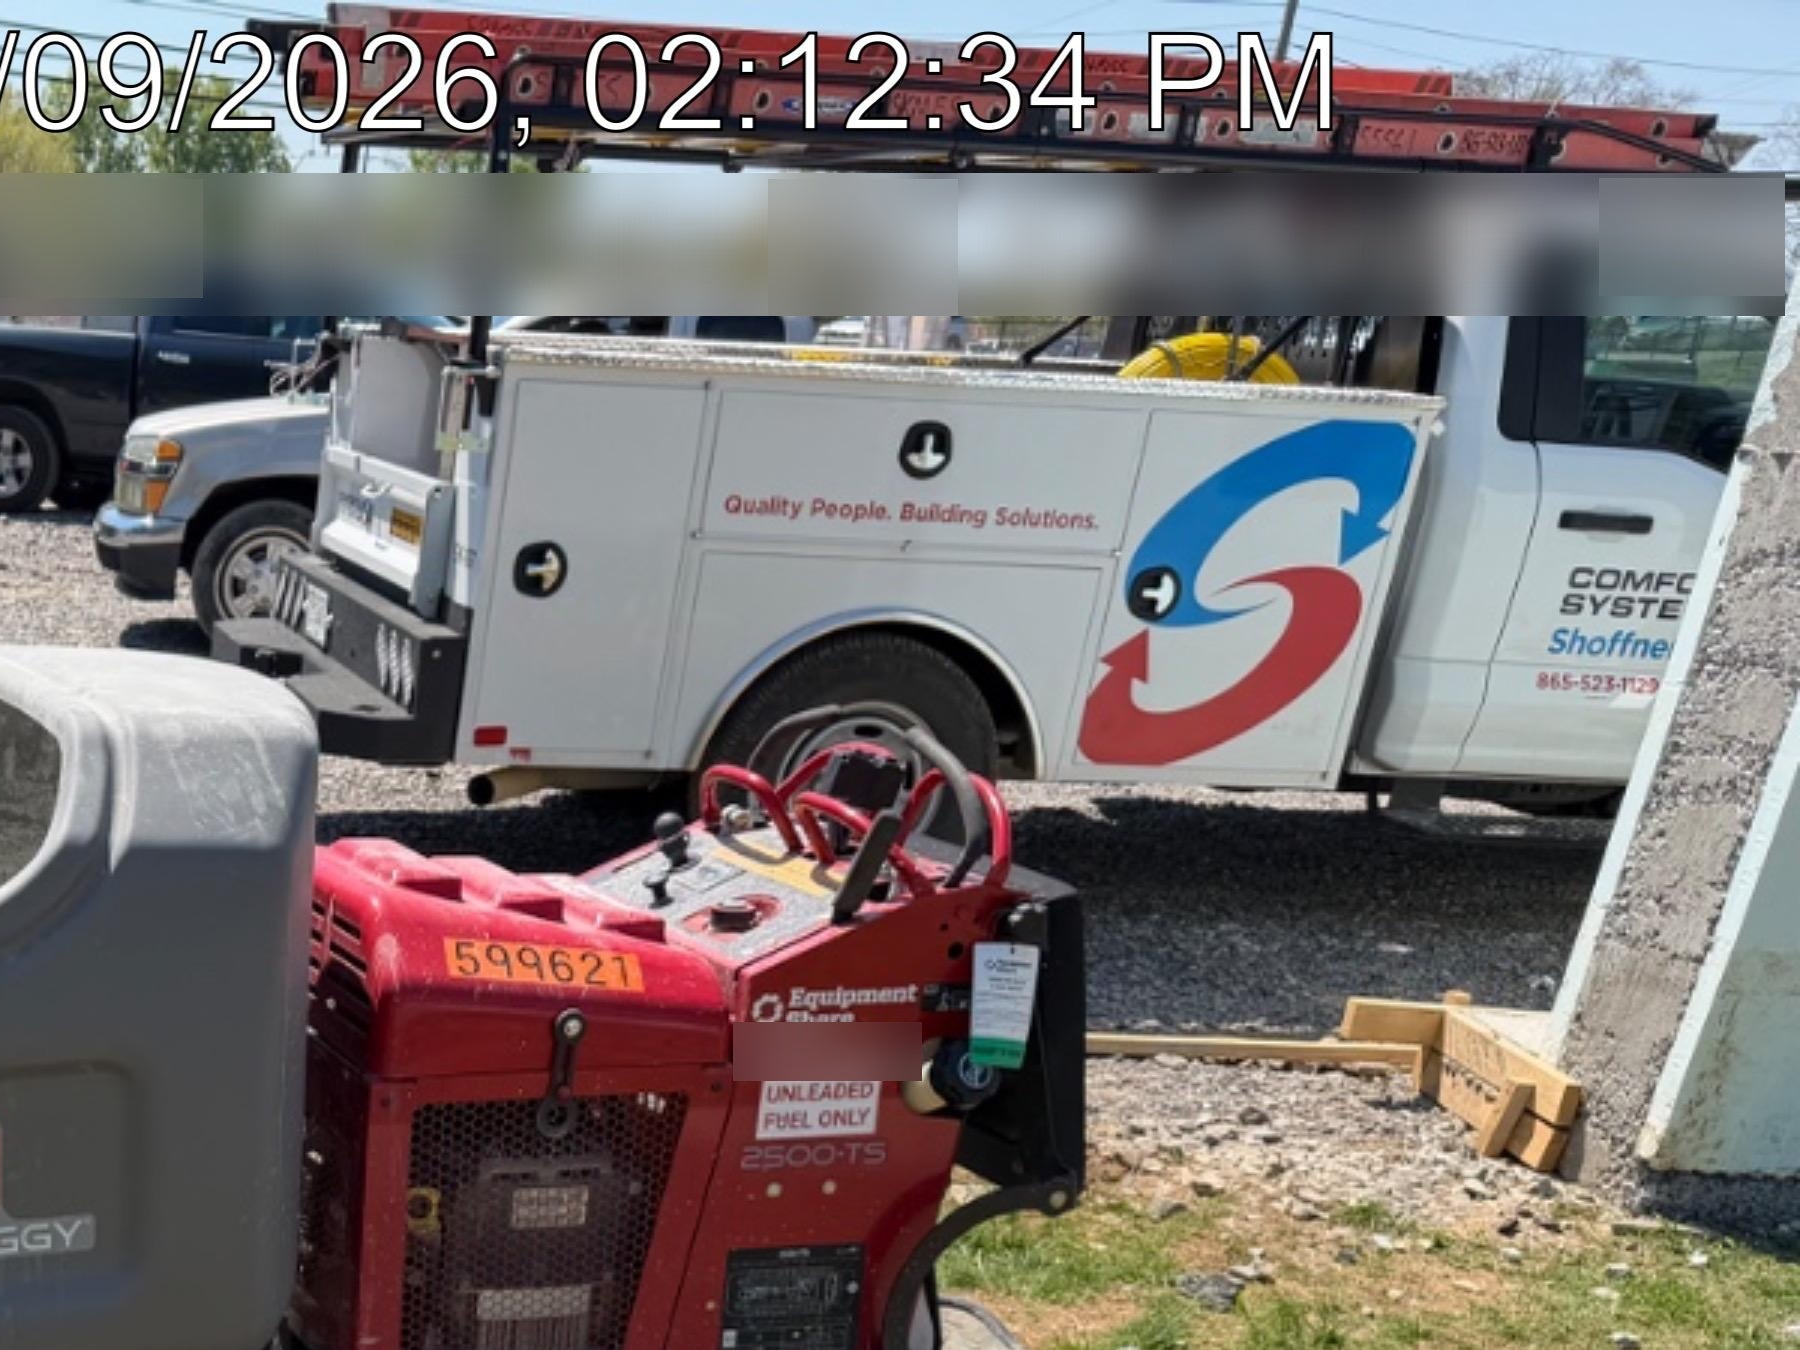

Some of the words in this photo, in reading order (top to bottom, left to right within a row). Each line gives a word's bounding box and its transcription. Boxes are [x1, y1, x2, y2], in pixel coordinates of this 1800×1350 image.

[724, 495, 802, 520] Quality
[809, 498, 893, 523] People.
[900, 502, 988, 529] Building
[995, 506, 1100, 531] Solutions.
[455, 941, 630, 988] 599621
[788, 983, 919, 1011] Equipment
[766, 1082, 875, 1104] UNLEADED
[763, 1110, 811, 1131] FUEL
[817, 1105, 871, 1128] ONLY
